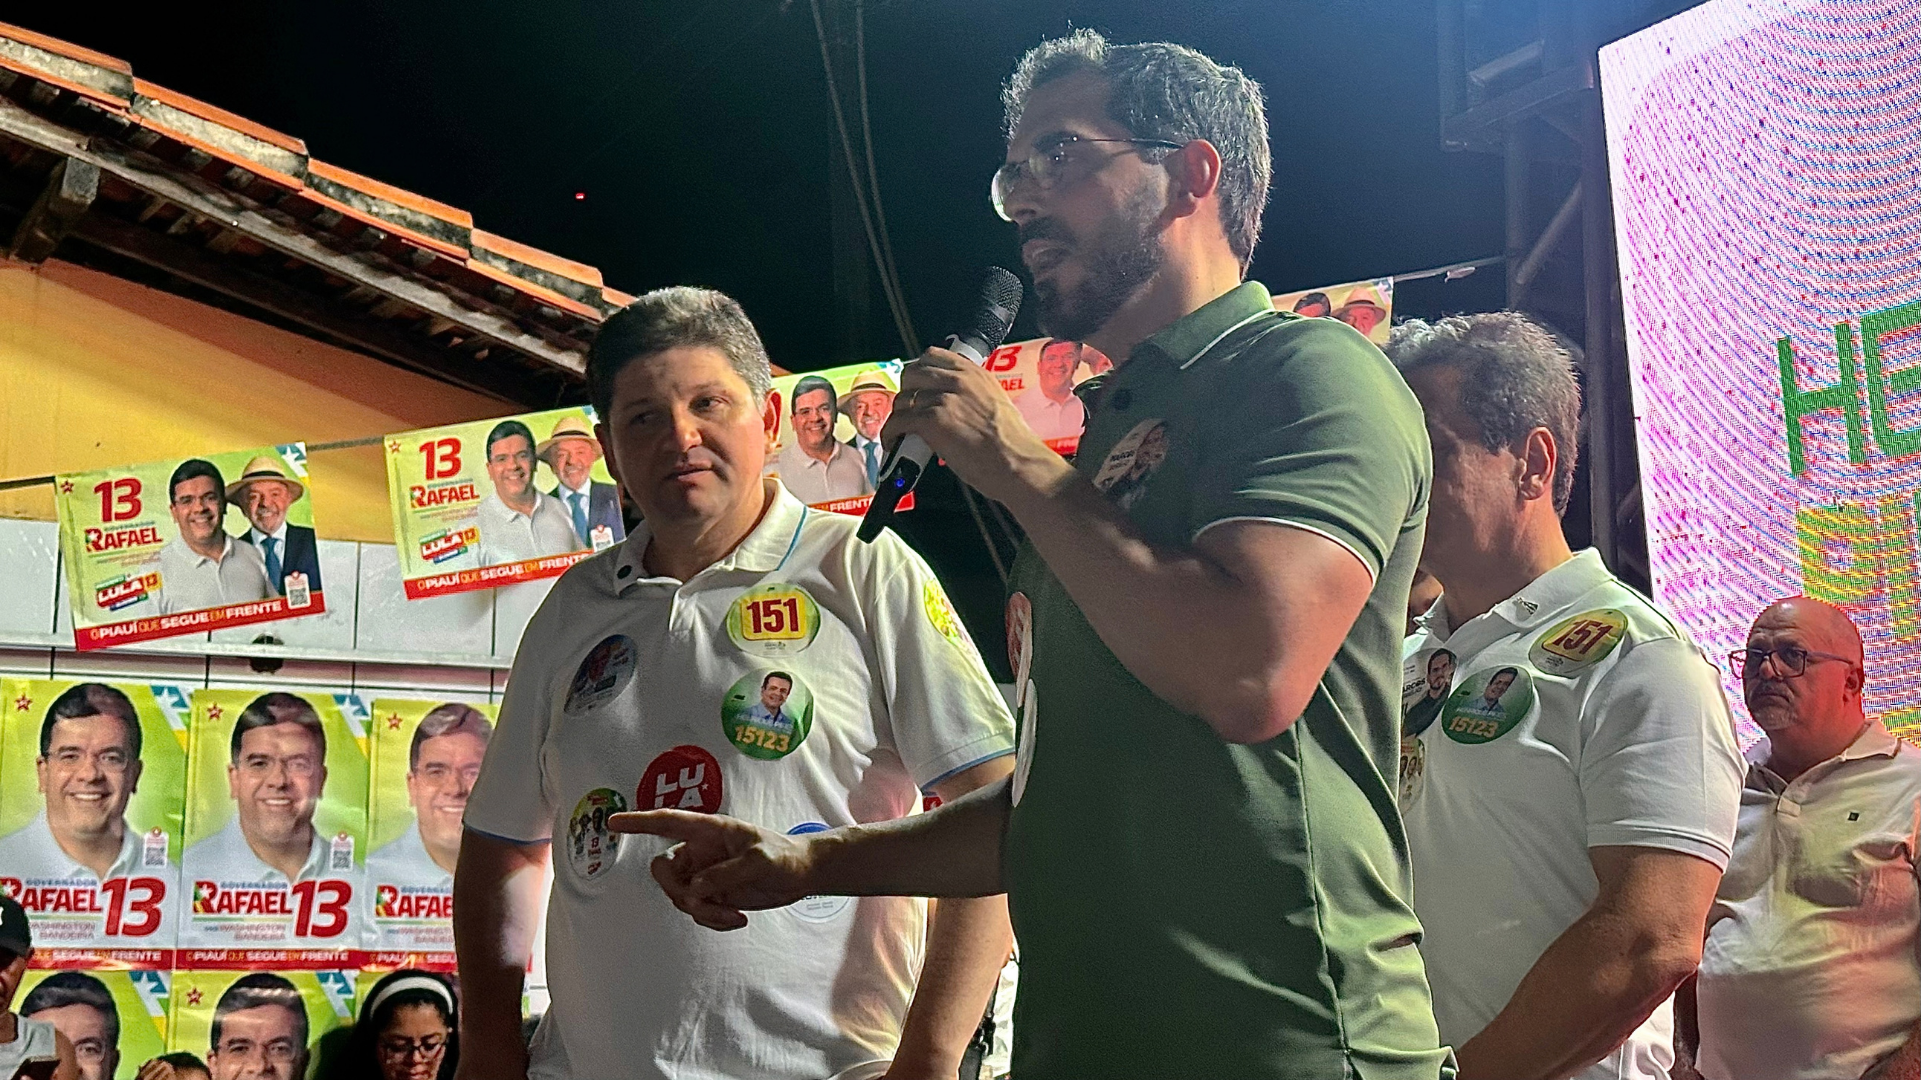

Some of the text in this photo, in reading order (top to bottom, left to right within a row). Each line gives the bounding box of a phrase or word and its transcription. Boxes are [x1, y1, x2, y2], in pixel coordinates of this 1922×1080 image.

[419, 437, 461, 480] 13
[94, 478, 143, 523] 13
[410, 484, 480, 508] RAFAEL
[830, 497, 872, 512] FRENT
[84, 527, 164, 552] RAFAEL
[422, 534, 462, 556] LULA
[426, 573, 460, 590] PIAUÍ
[460, 570, 480, 583] QUE
[480, 564, 524, 581] SEGUE
[98, 580, 143, 603] LULA
[100, 621, 138, 639] PIAUÍ
[138, 620, 160, 632] QUE
[160, 611, 209, 630] SEGUE
[226, 601, 282, 619] FRENTE
[747, 598, 799, 634] 151
[1552, 620, 1614, 655] 151
[735, 725, 791, 752] 15123
[1449, 716, 1499, 738] 15123
[656, 763, 705, 796] LU
[101, 877, 166, 937] 13
[193, 880, 353, 938] RAFAEL 13
[376, 885, 452, 917] RAFAE
[53, 951, 95, 961] SEGUE
[111, 951, 162, 961] FRENTE
[193, 950, 227, 961] PIAUÍ
[246, 951, 287, 961] SEGUE
[301, 950, 349, 961] FRENTE
[427, 953, 456, 963] SEGU
